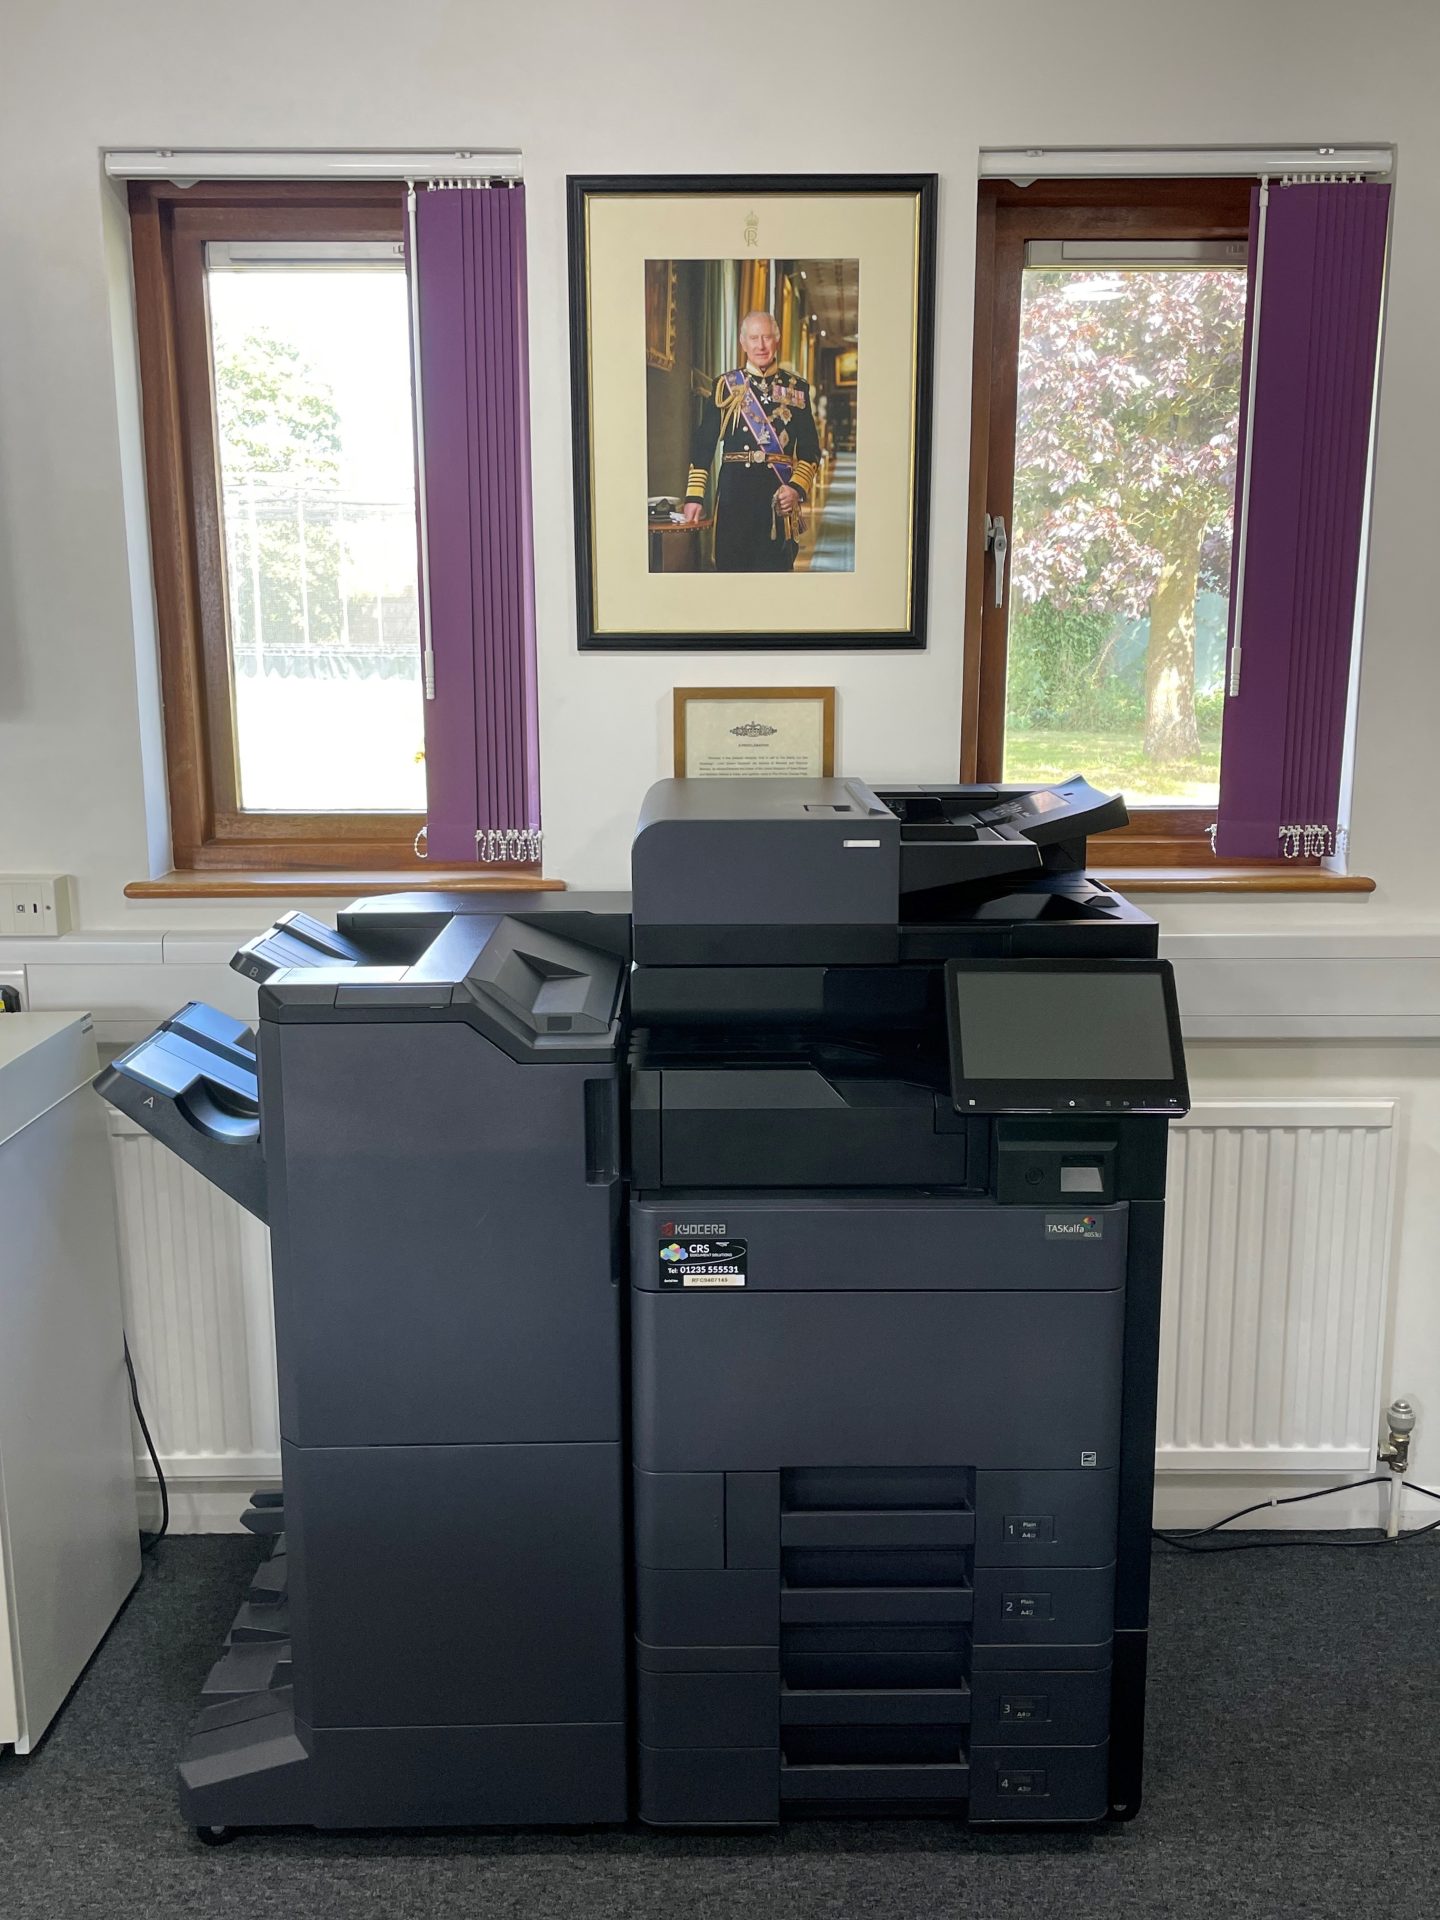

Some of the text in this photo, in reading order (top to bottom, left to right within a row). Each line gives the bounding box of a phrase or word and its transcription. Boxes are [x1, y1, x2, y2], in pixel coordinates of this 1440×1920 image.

[249, 966, 259, 978] B
[143, 1096, 154, 1109] A
[675, 1224, 726, 1235] KYOCERA
[1047, 1224, 1085, 1233] TASKalfa
[689, 1244, 710, 1253] CRS
[680, 1266, 707, 1274] 01235
[708, 1265, 738, 1274] 555531
[1008, 1524, 1014, 1534] 1
[1006, 1601, 1013, 1612] 2
[1003, 1704, 1011, 1714] 3
[1001, 1779, 1009, 1788] 4
